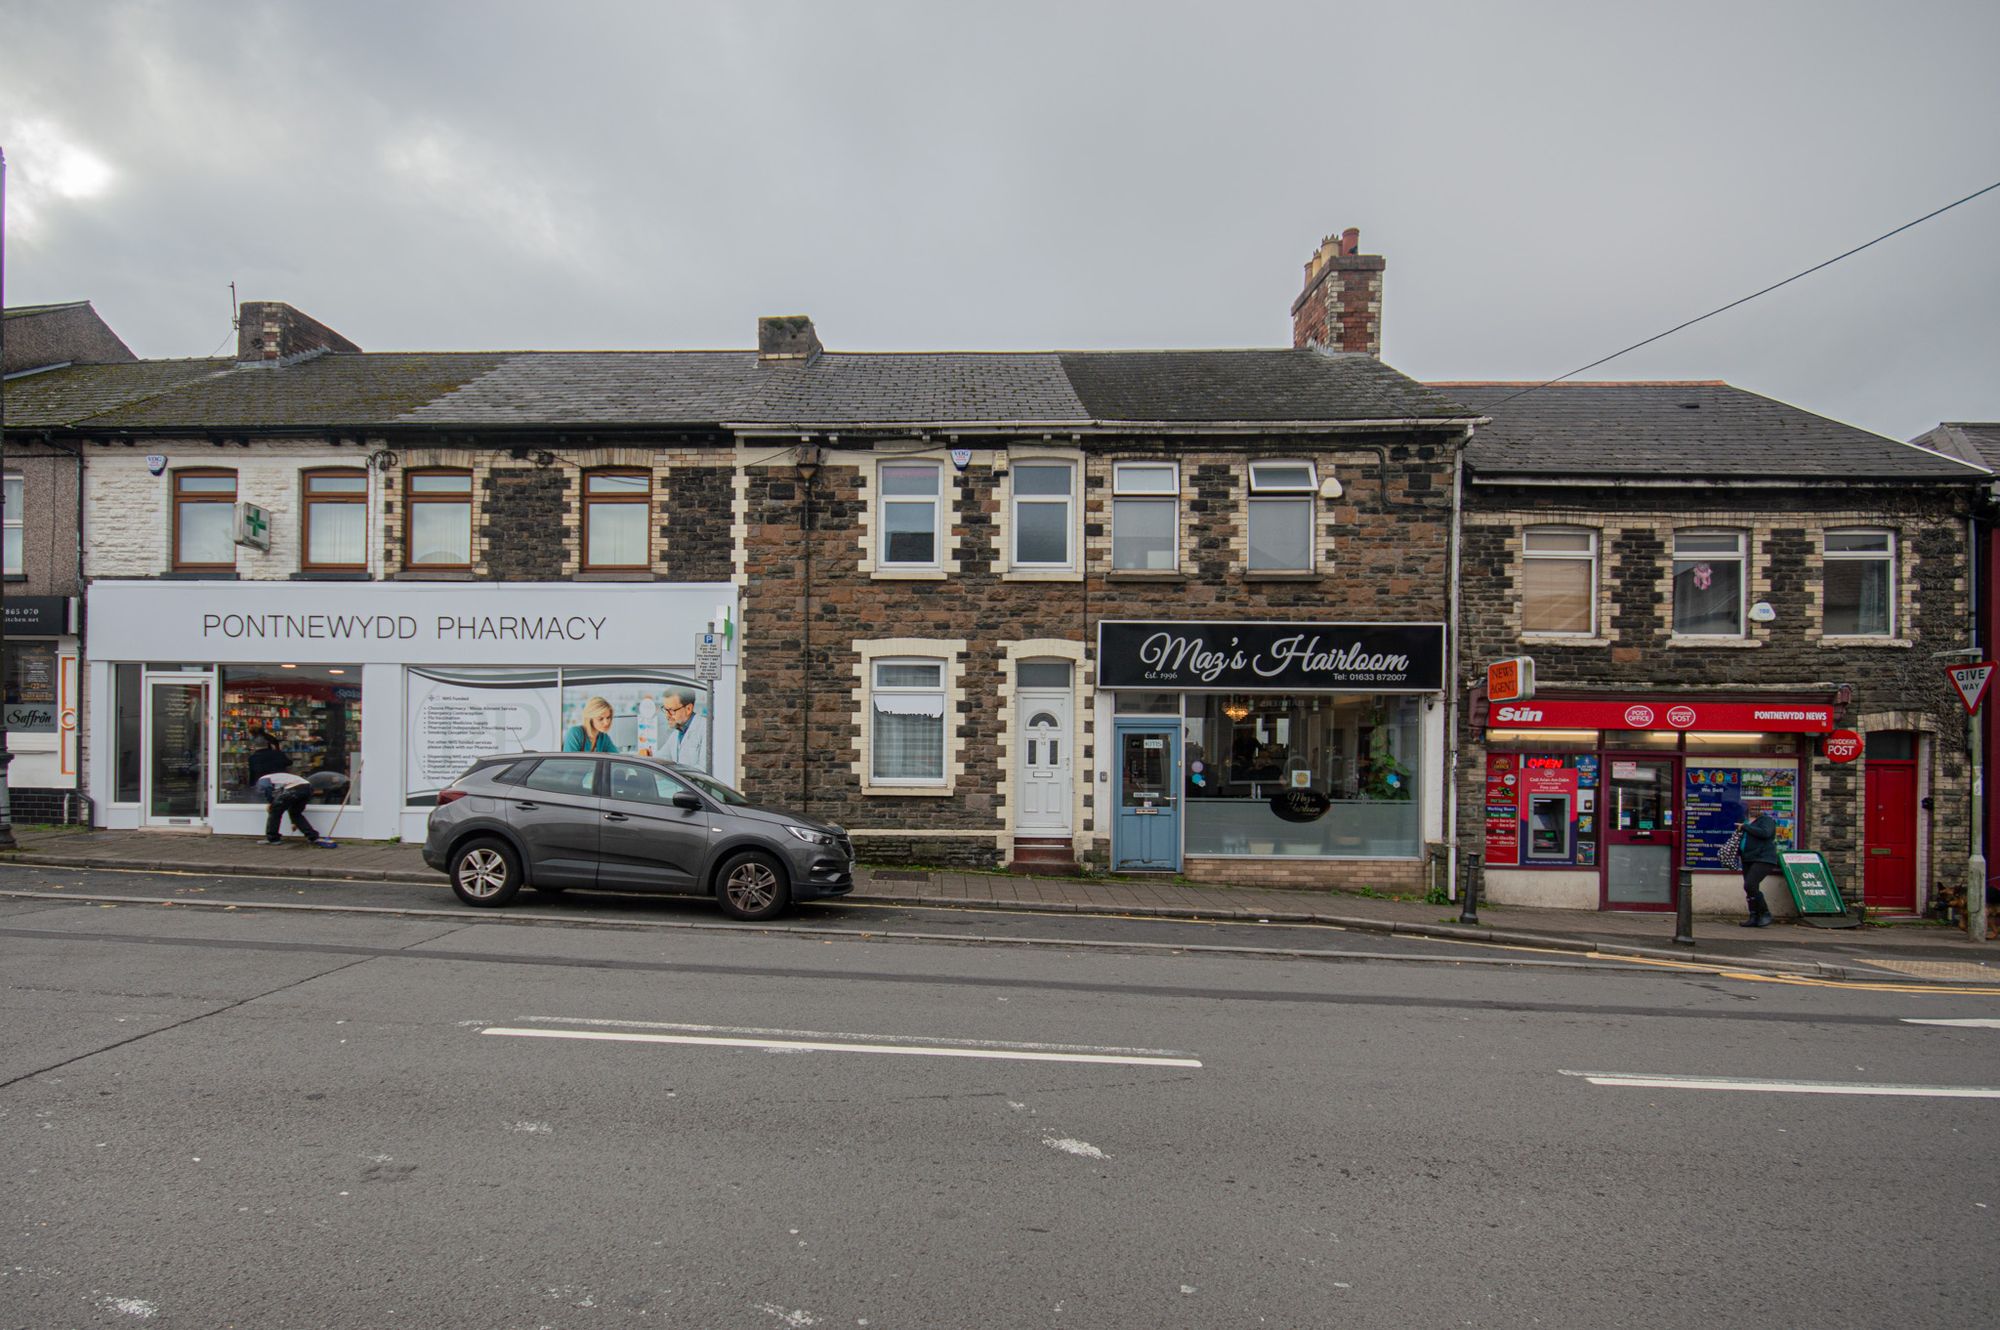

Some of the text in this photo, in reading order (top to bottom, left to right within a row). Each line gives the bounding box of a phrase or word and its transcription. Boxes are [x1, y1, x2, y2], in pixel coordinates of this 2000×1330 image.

[203, 614, 607, 640] PONTNEWYDD PHARMACY
[1140, 632, 1410, 682] Maz's Hairloom
[1160, 672, 1178, 680] 1996
[1492, 666, 1514, 679] NEWS
[1956, 669, 1985, 680] GIVE
[1491, 681, 1515, 694] AGENT
[1962, 682, 1980, 690] WAY
[7, 709, 52, 728] Saffron
[1754, 711, 1827, 720] PONTNEWYDD NEWS
[1828, 746, 1855, 756] POST
[1527, 758, 1564, 769] OPEN
